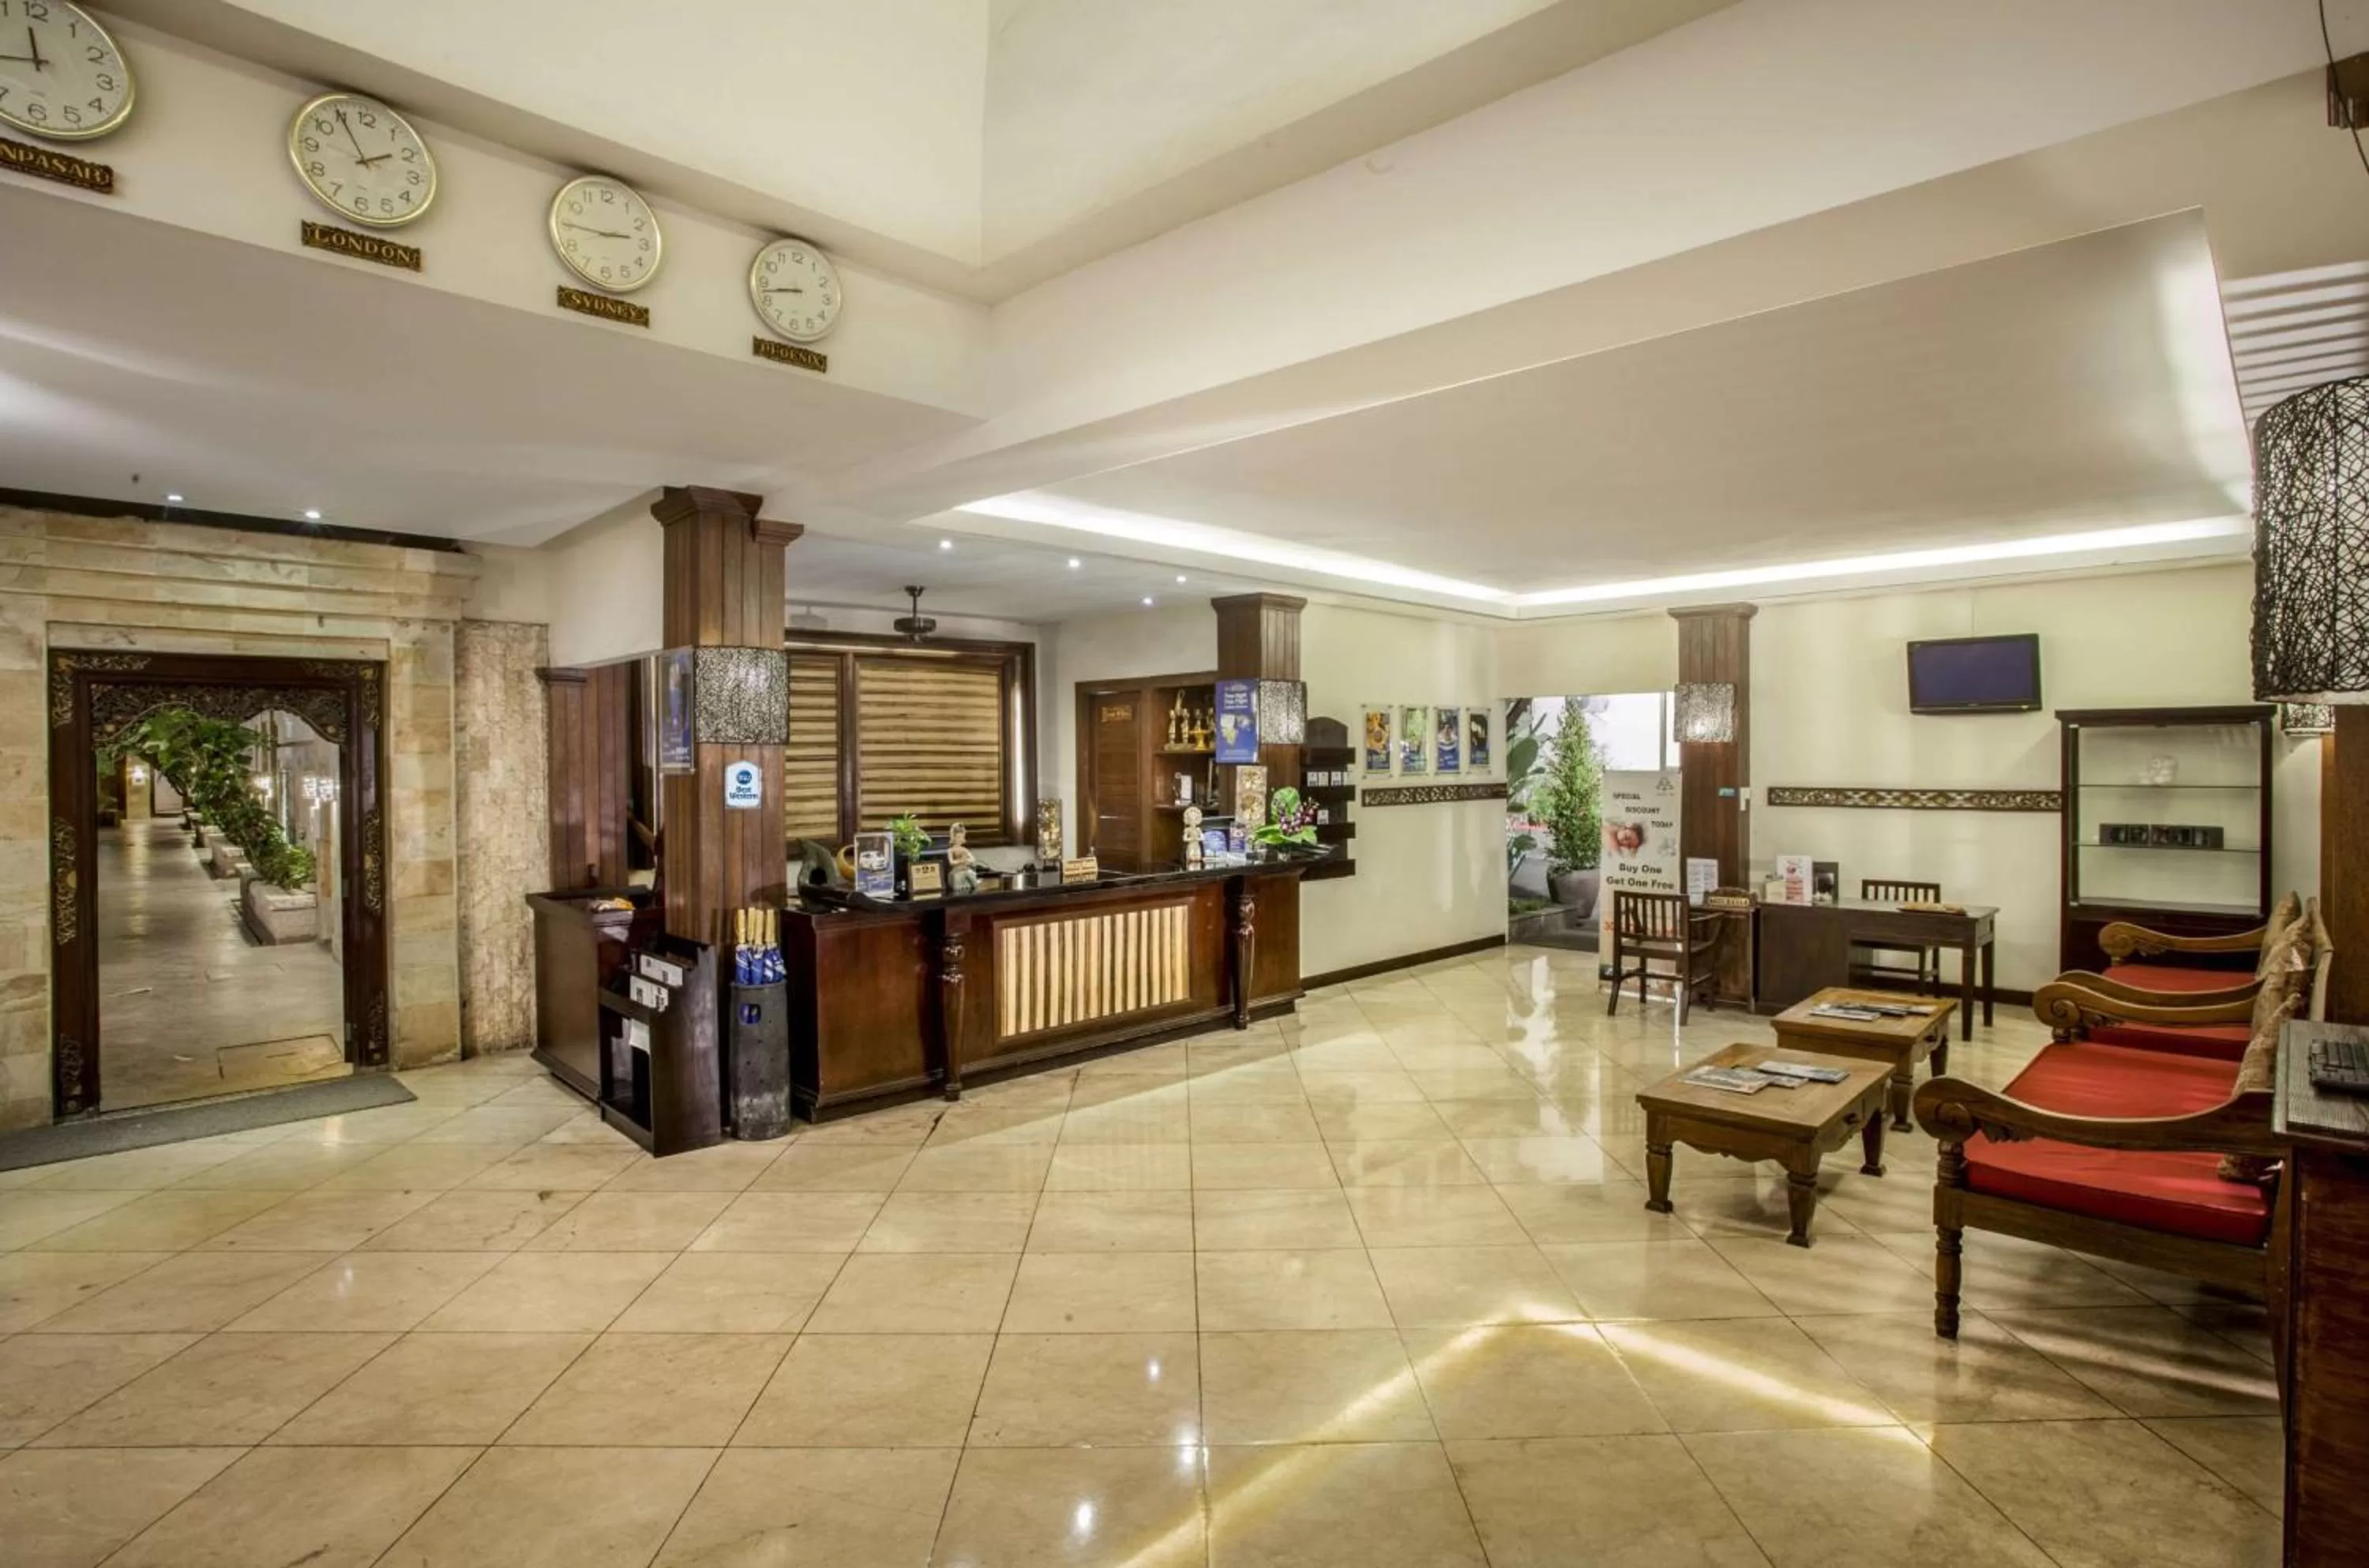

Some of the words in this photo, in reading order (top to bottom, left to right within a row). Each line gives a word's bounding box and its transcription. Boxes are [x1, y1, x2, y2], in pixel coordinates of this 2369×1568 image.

[24, 1, 48, 23] 12
[69, 22, 77, 38] 1
[87, 46, 105, 65] 2
[96, 73, 115, 92] 3
[28, 103, 47, 121] 6
[88, 97, 103, 113] 4
[63, 105, 81, 123] 5
[358, 111, 377, 129] 12
[314, 118, 334, 136] 10
[304, 137, 319, 152] 9
[401, 148, 415, 163] 2
[310, 161, 325, 177] 8
[407, 171, 420, 186] 3
[329, 181, 342, 197] 7
[399, 190, 411, 203] 4
[584, 189, 592, 202] 11
[600, 189, 614, 204] 12
[355, 197, 368, 212] 6
[633, 218, 645, 231] 2
[315, 227, 411, 263] LONDON
[638, 238, 650, 251] 3
[634, 256, 643, 267] 4
[778, 253, 786, 264] 11
[792, 253, 803, 264] 12
[600, 265, 612, 279] 6
[620, 265, 630, 278] 5
[819, 277, 828, 288] 2
[571, 293, 637, 317] SYDNEY
[822, 294, 832, 306] 3
[1619, 863, 1639, 873] Buy
[1642, 865, 1662, 873] One
[1606, 876, 1624, 885] Get
[1628, 878, 1647, 887] One
[1651, 880, 1674, 889] Free
